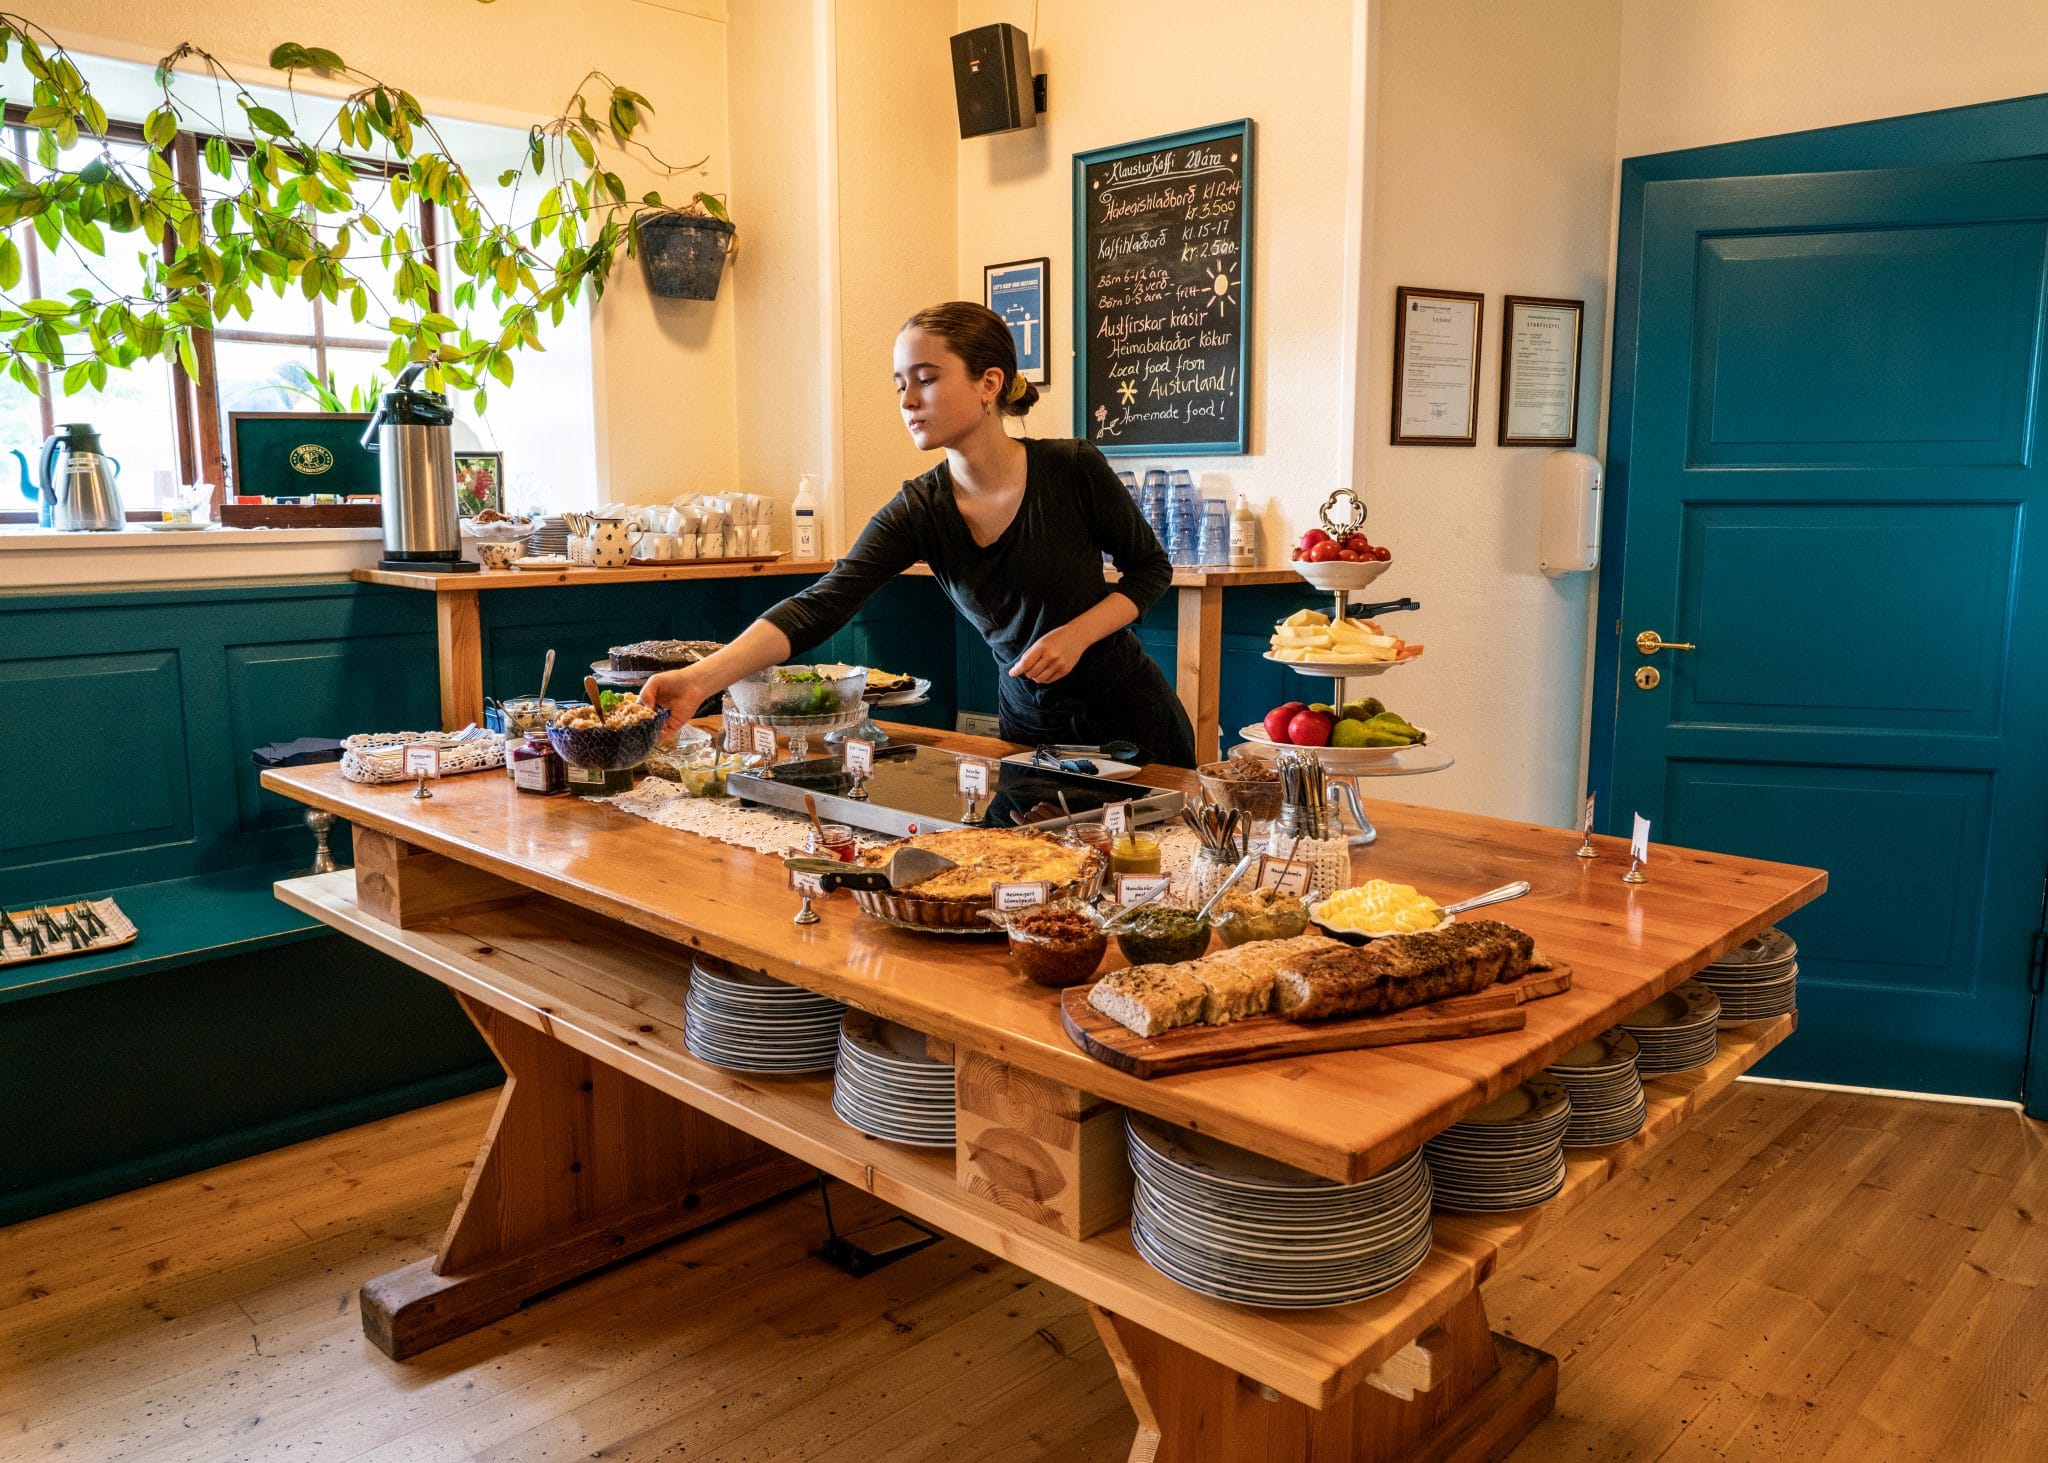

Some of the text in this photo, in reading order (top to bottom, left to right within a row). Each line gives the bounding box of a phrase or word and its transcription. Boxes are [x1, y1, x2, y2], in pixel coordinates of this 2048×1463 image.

[1197, 219, 1230, 238] 15-17
[1097, 266, 1168, 288] Börn 6-12 ára
[1098, 295, 1123, 309] Börn
[1096, 305, 1209, 342] Austfirskar krásir
[1107, 331, 1196, 359] Heimabakaðar
[1108, 354, 1206, 382] Local food from
[1119, 402, 1180, 425] Homemade
